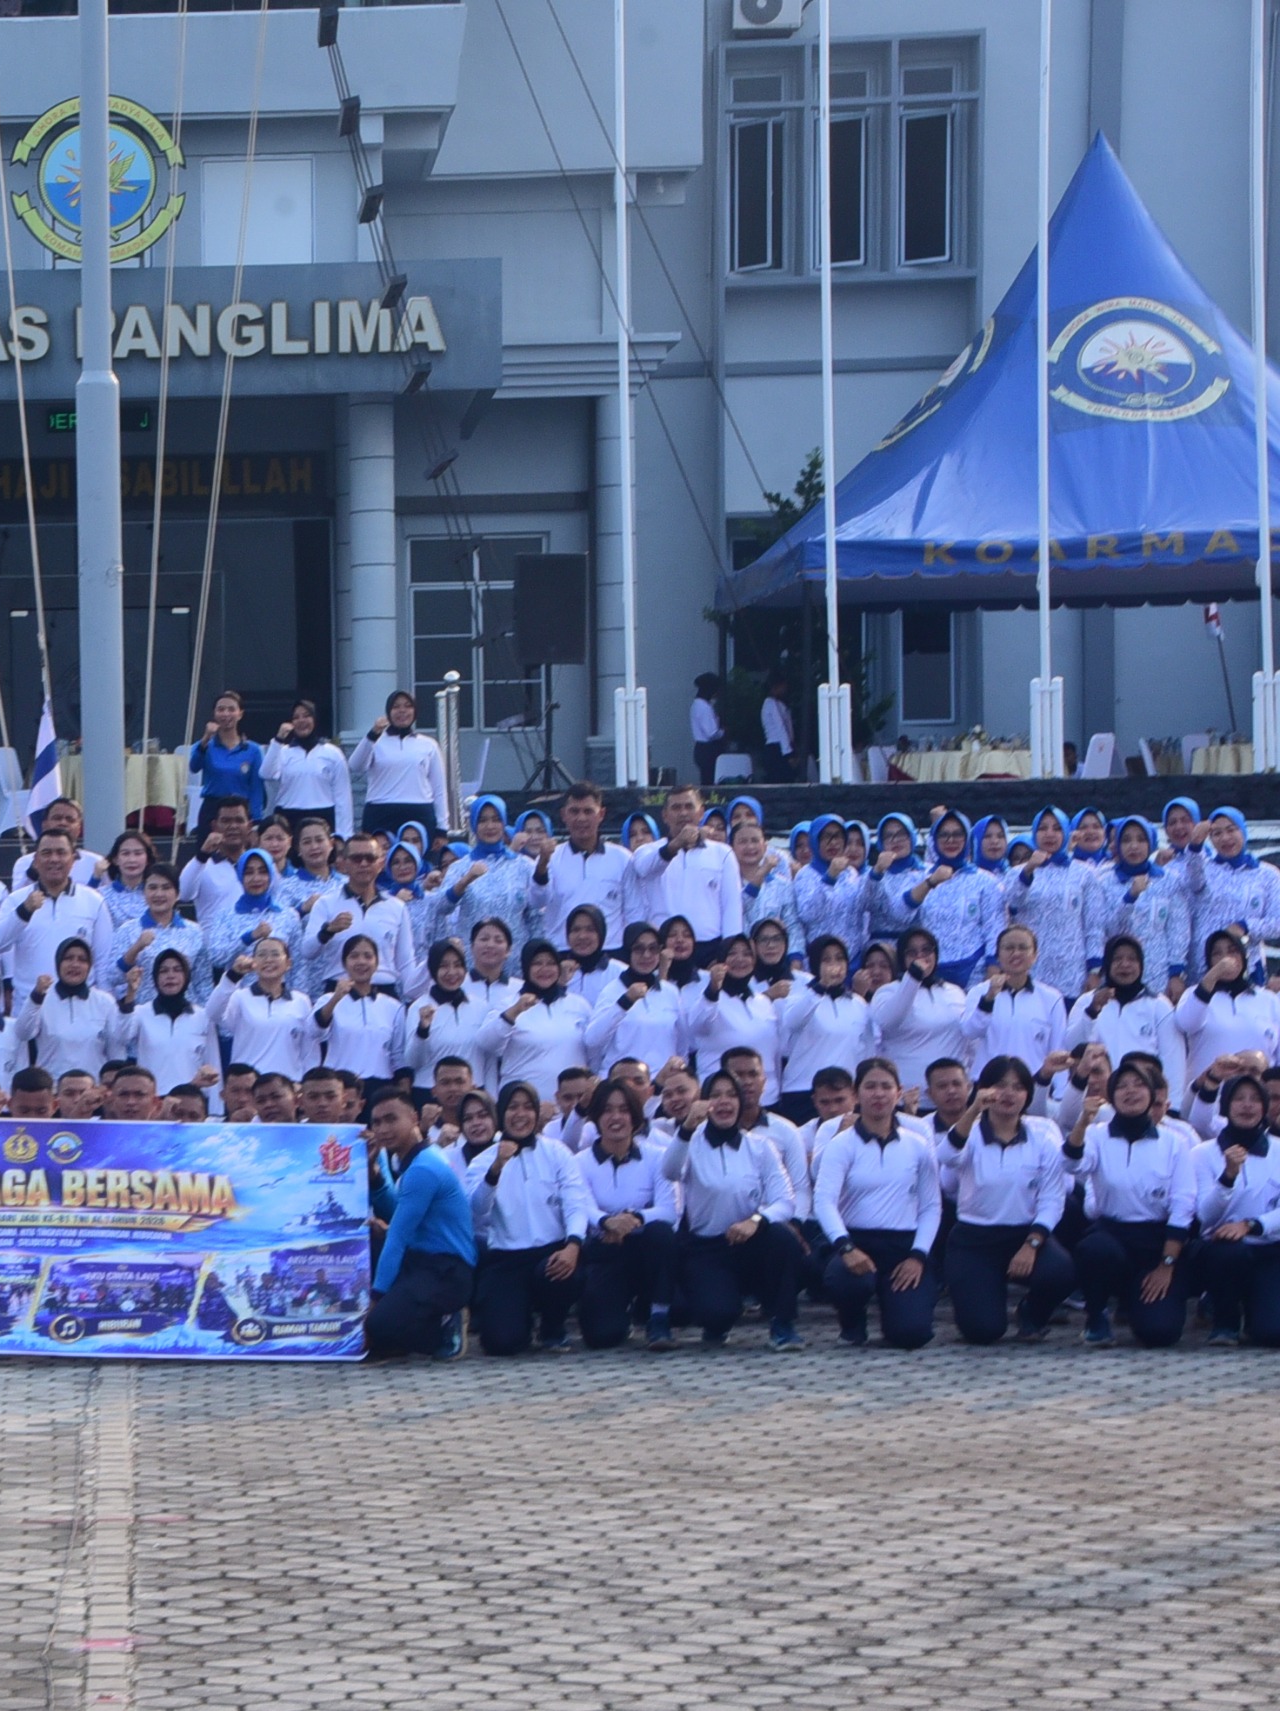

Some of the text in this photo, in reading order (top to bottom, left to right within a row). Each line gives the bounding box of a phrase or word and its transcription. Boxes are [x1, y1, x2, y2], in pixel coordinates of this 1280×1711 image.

[108, 100, 142, 119] ADYA
[923, 527, 1280, 566] KOARMA
[61, 1168, 239, 1216] BERSAMA
